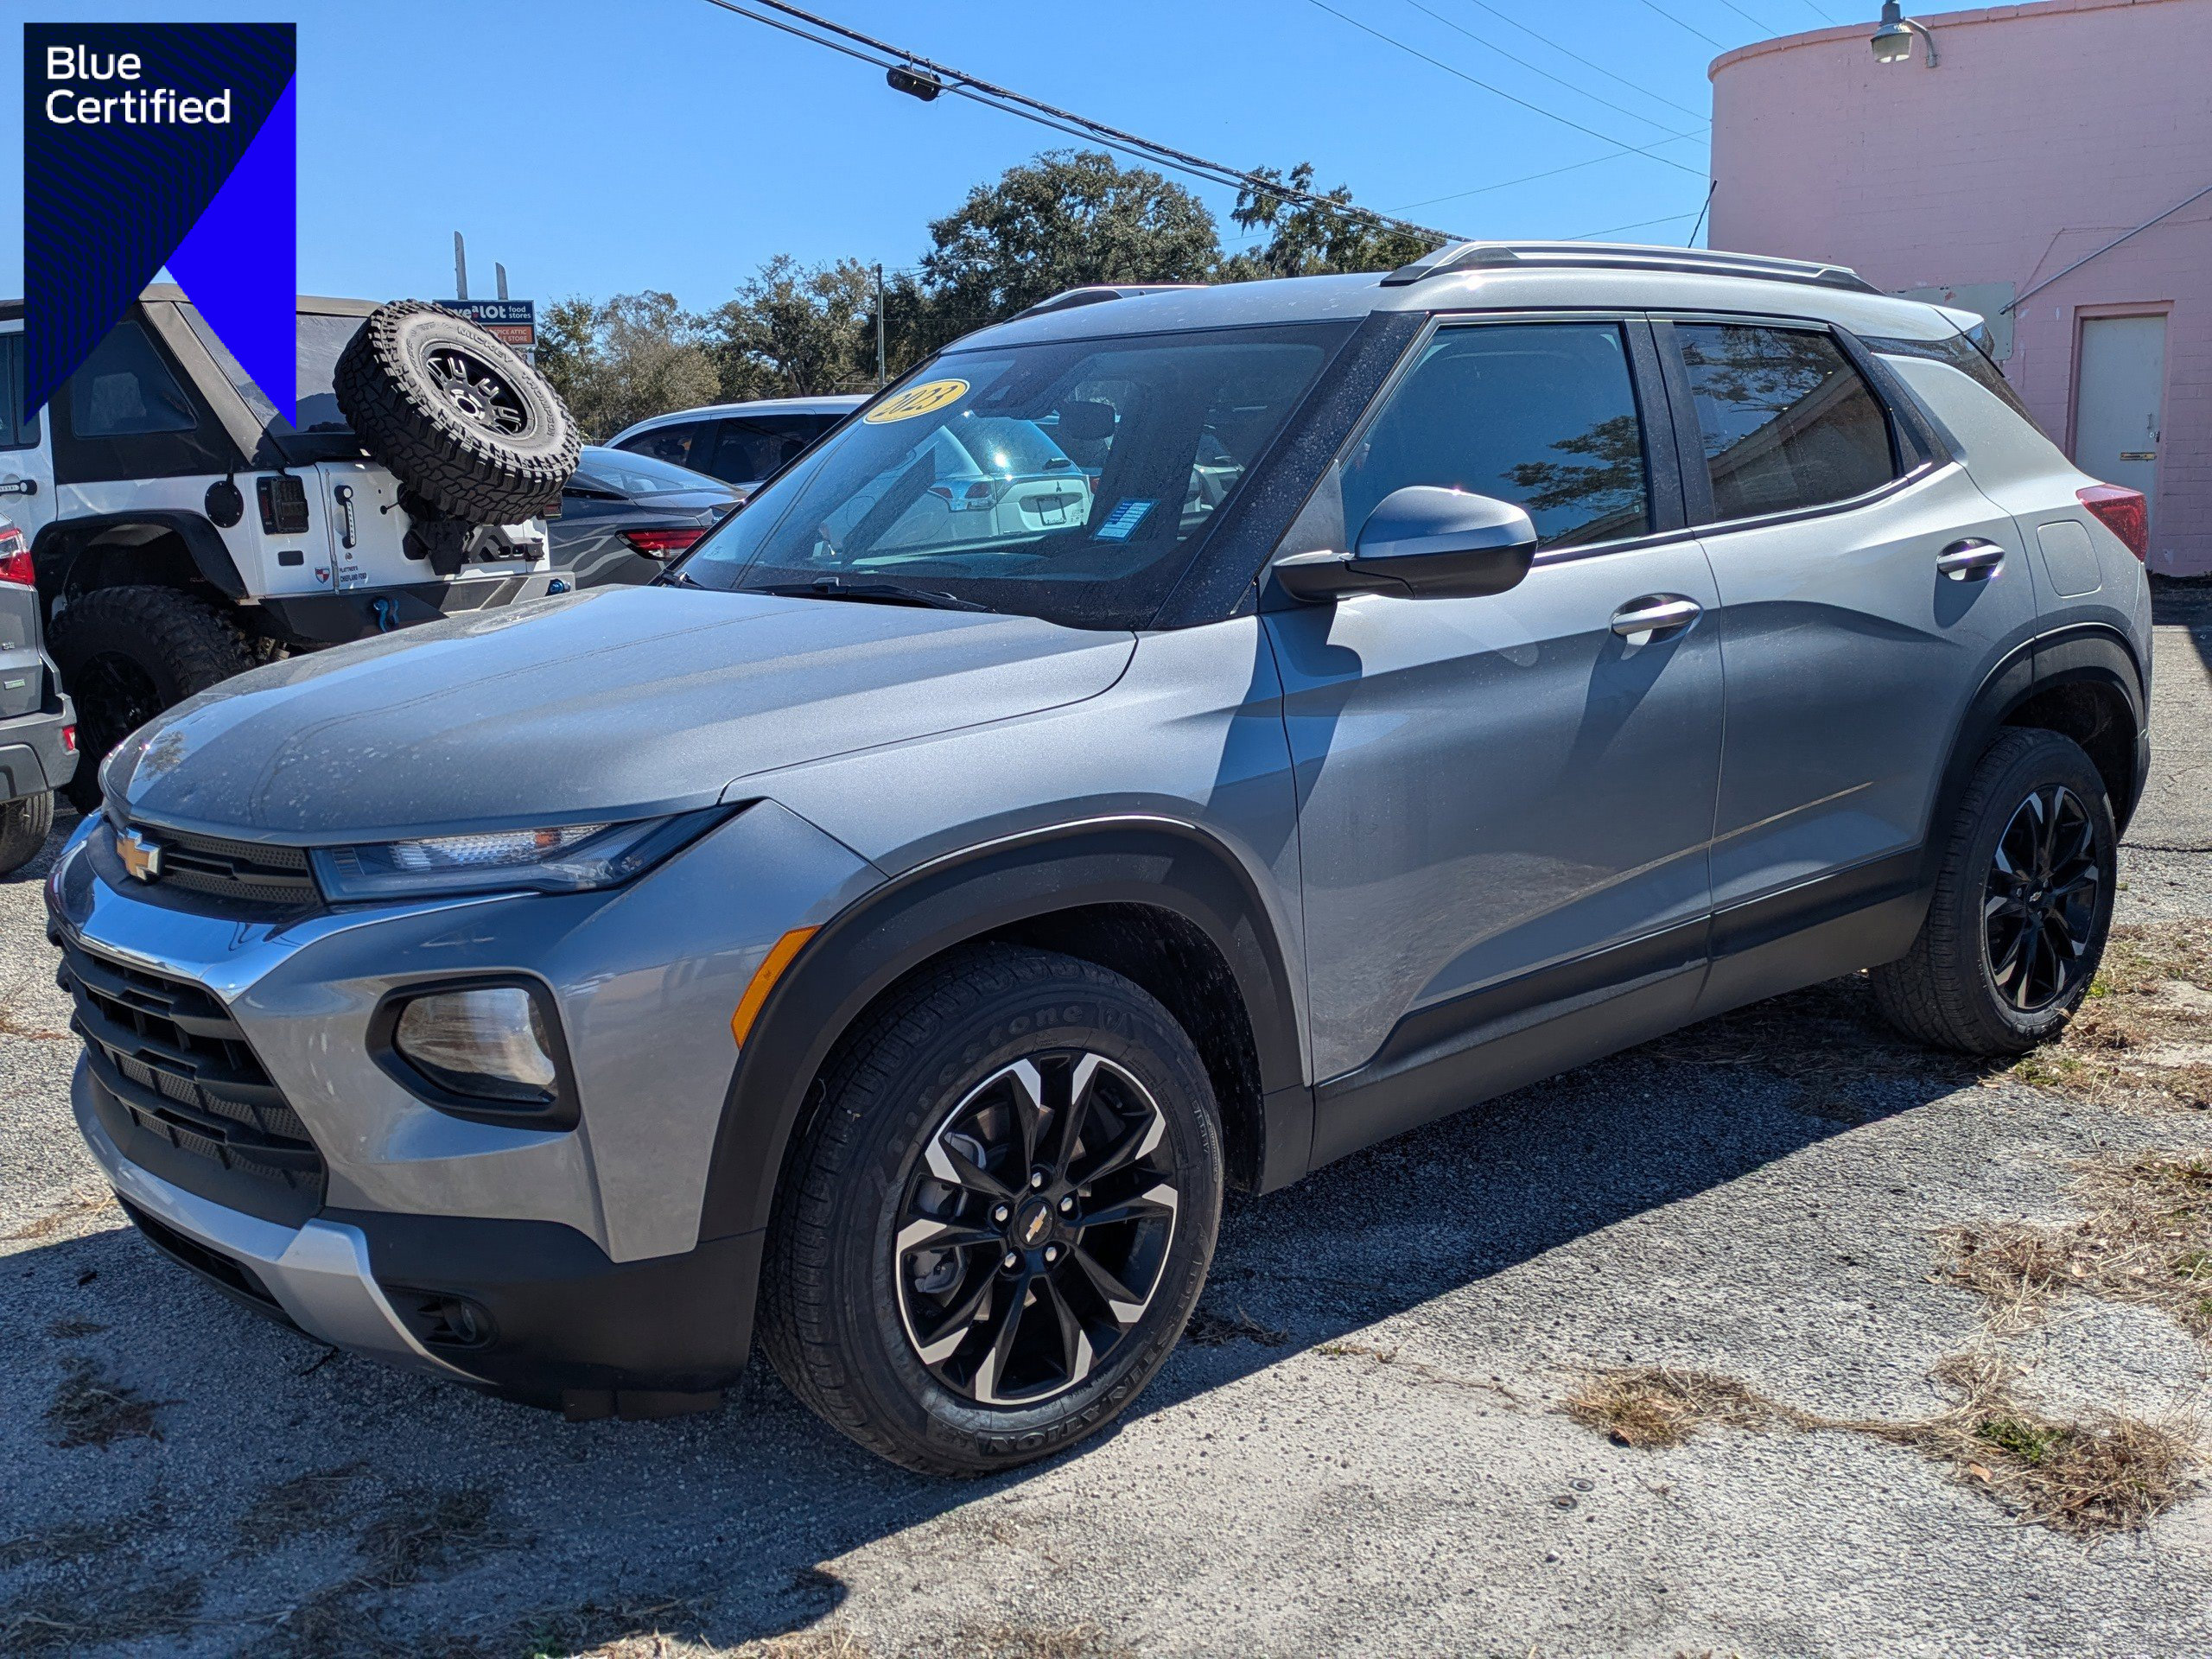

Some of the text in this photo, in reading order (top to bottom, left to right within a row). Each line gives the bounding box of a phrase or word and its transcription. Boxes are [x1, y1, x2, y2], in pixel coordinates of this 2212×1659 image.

[456, 326, 556, 437] MICKEY THOMPSON
[872, 385, 958, 418] 2023
[887, 1004, 1084, 1157] Firestone
[987, 1258, 1204, 1453] DESTINATION
